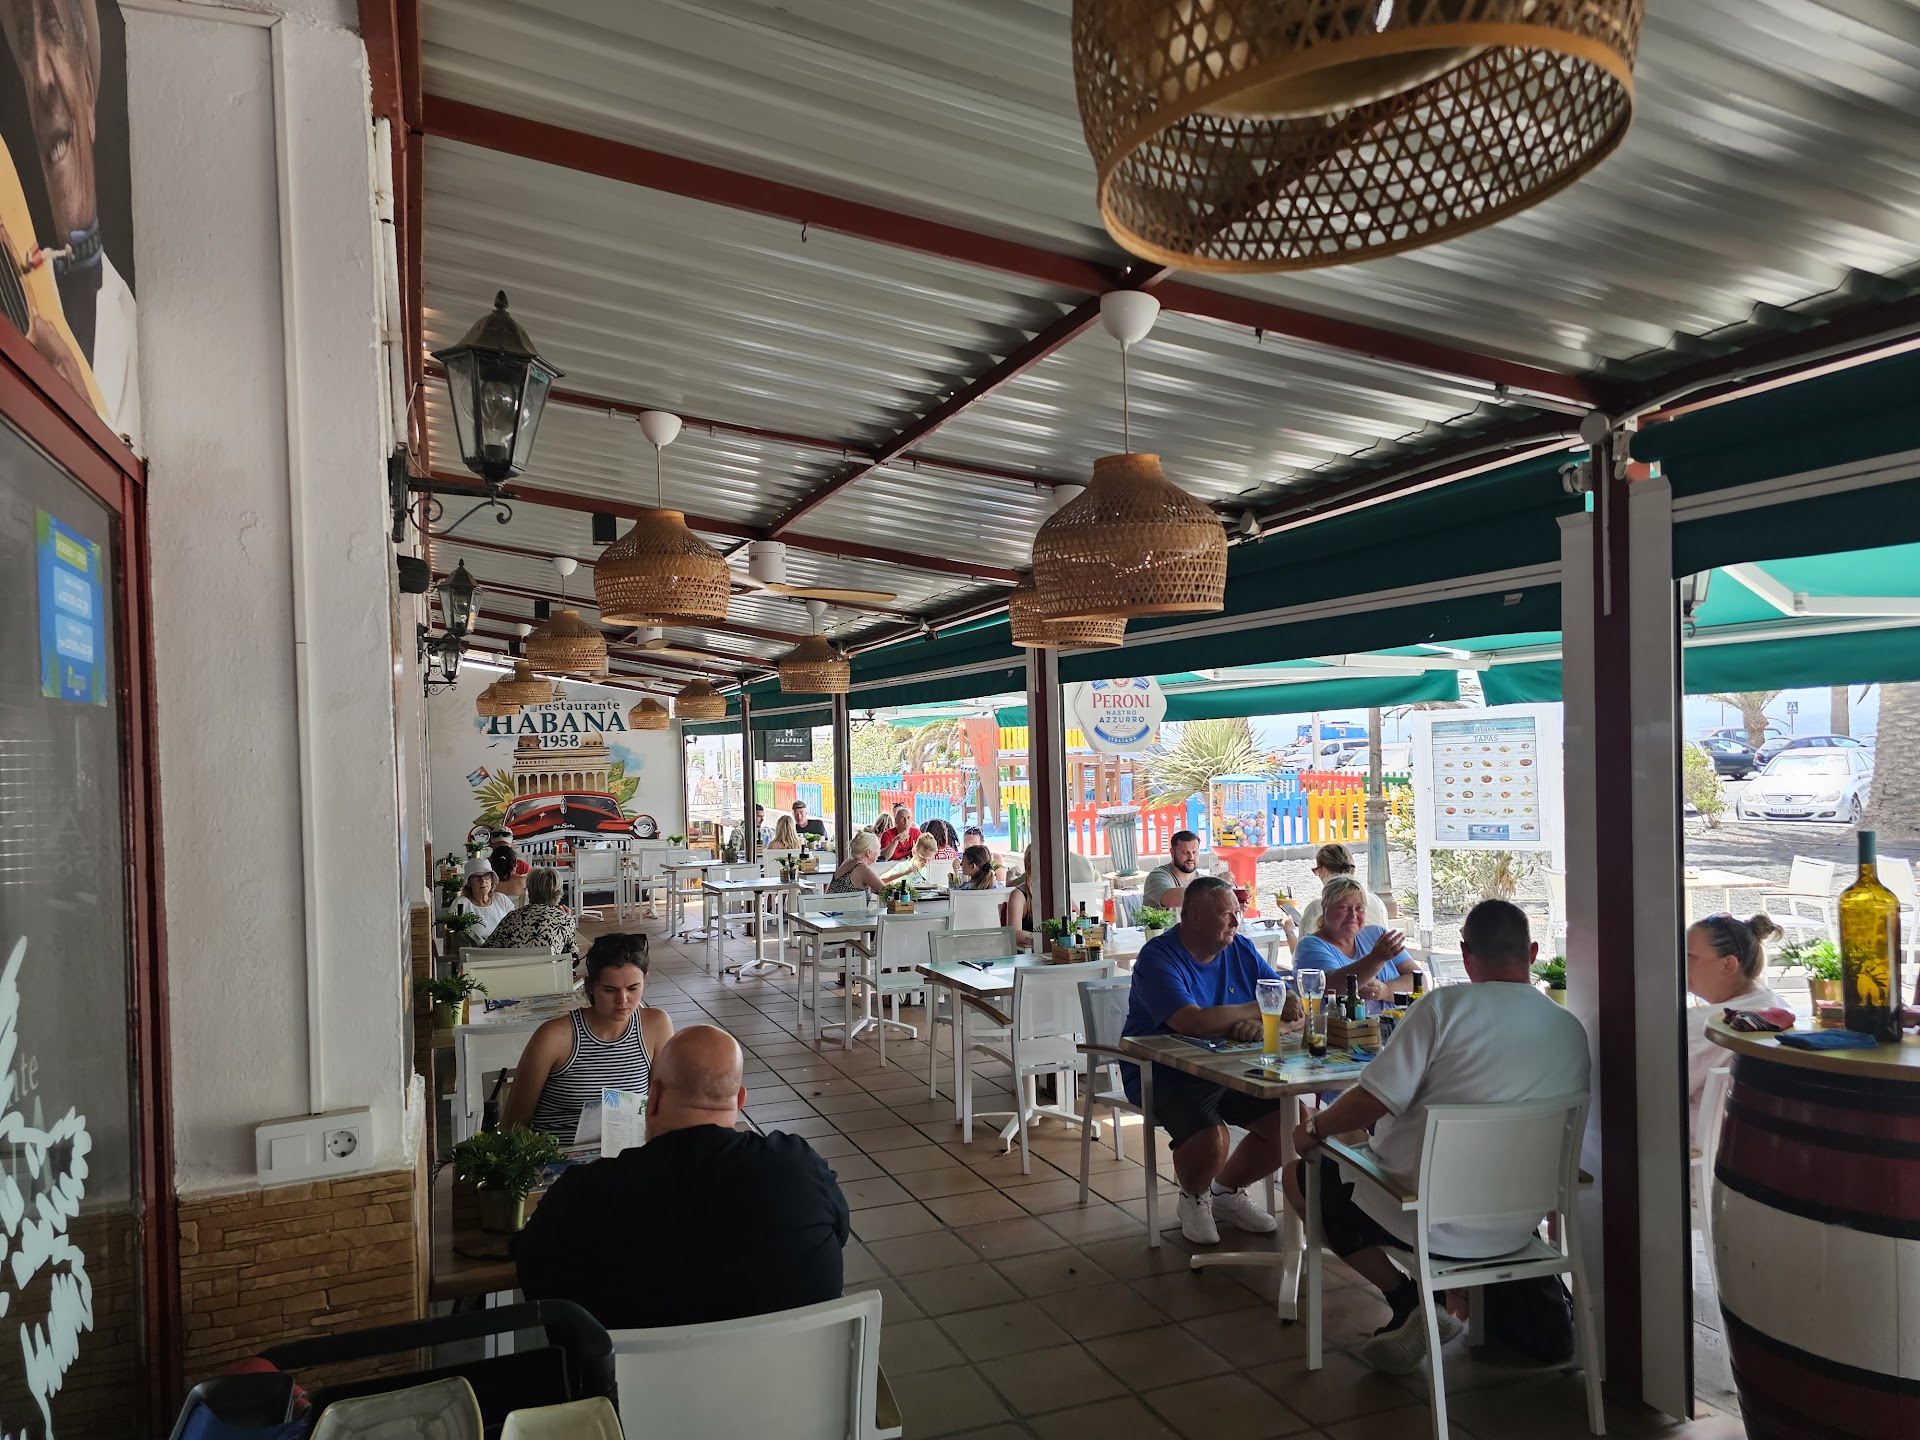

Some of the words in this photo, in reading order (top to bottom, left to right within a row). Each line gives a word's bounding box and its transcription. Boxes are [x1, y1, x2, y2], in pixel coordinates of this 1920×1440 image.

[538, 701, 620, 711] restaurante
[1092, 693, 1150, 708] PERONI
[486, 711, 627, 734] HABANA
[540, 734, 579, 747] 1958
